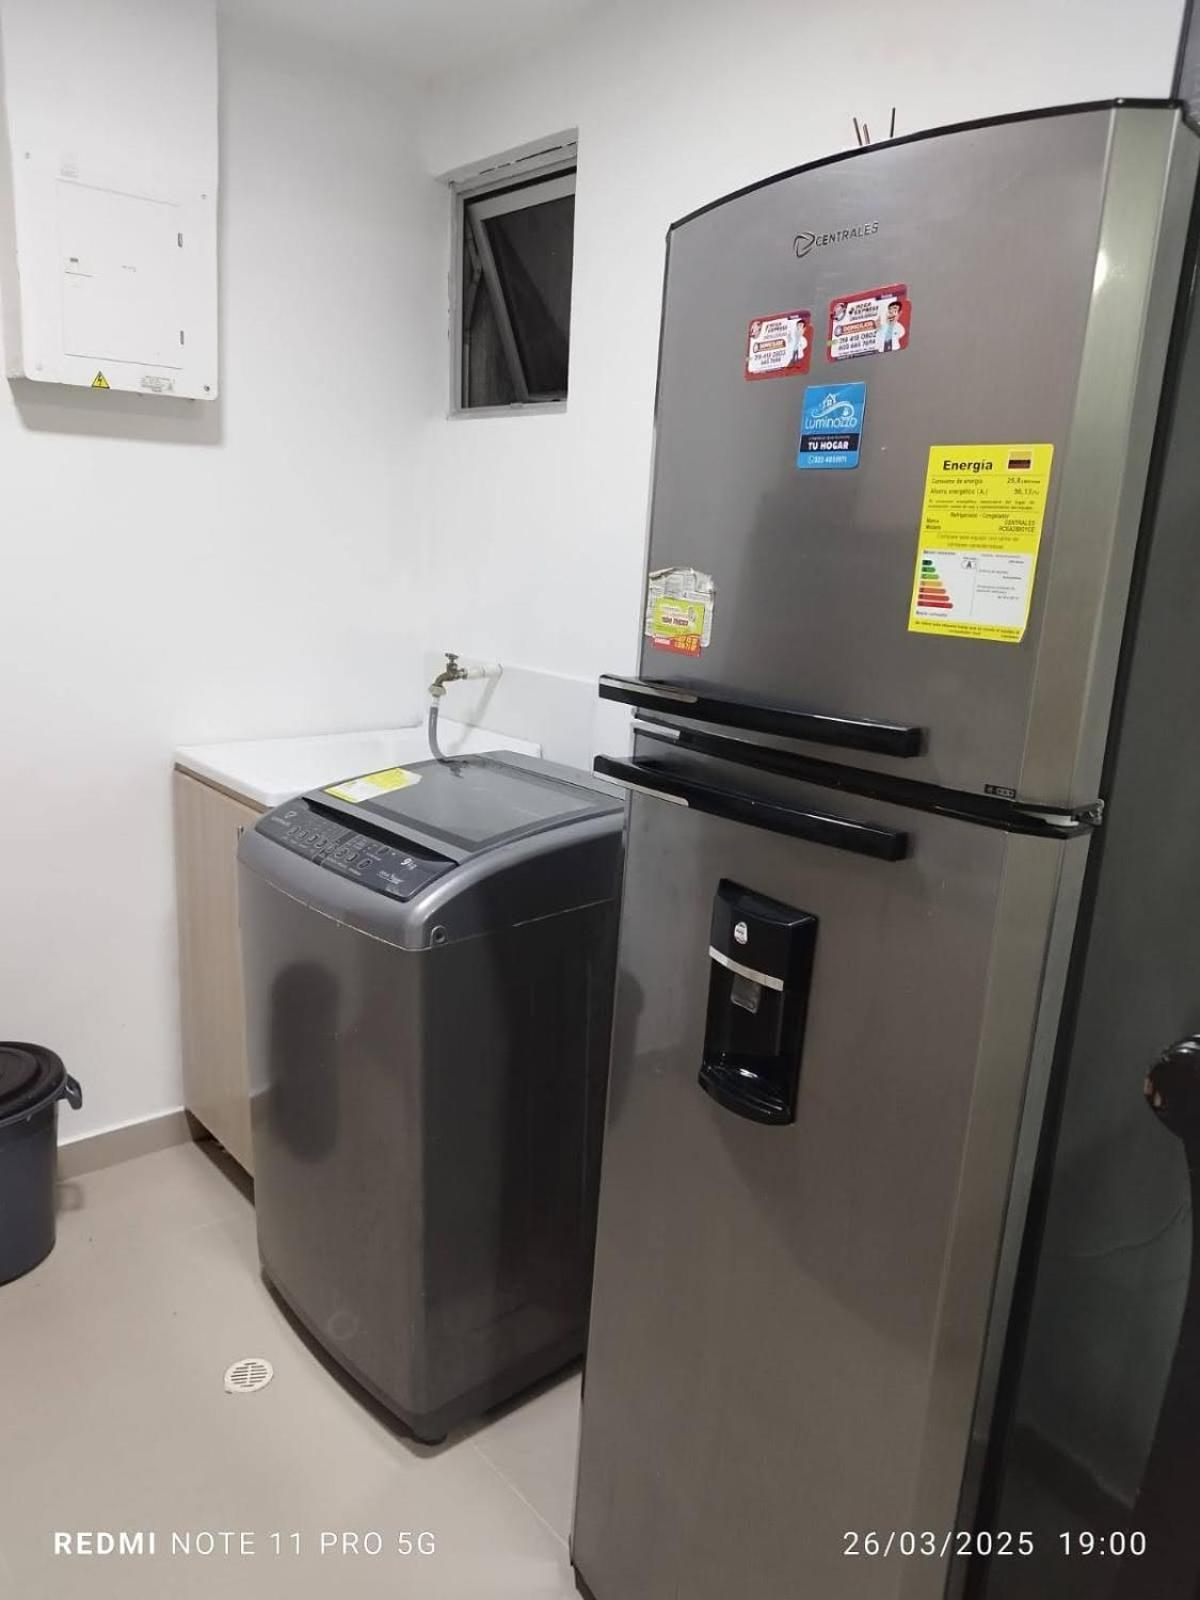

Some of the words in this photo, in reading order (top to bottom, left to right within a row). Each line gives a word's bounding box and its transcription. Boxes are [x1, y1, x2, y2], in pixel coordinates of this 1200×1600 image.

[815, 220, 879, 247] CENTRALES
[808, 441, 819, 450] TU
[820, 441, 849, 450] HOGAR
[943, 459, 993, 473] Energía
[965, 561, 973, 569] A
